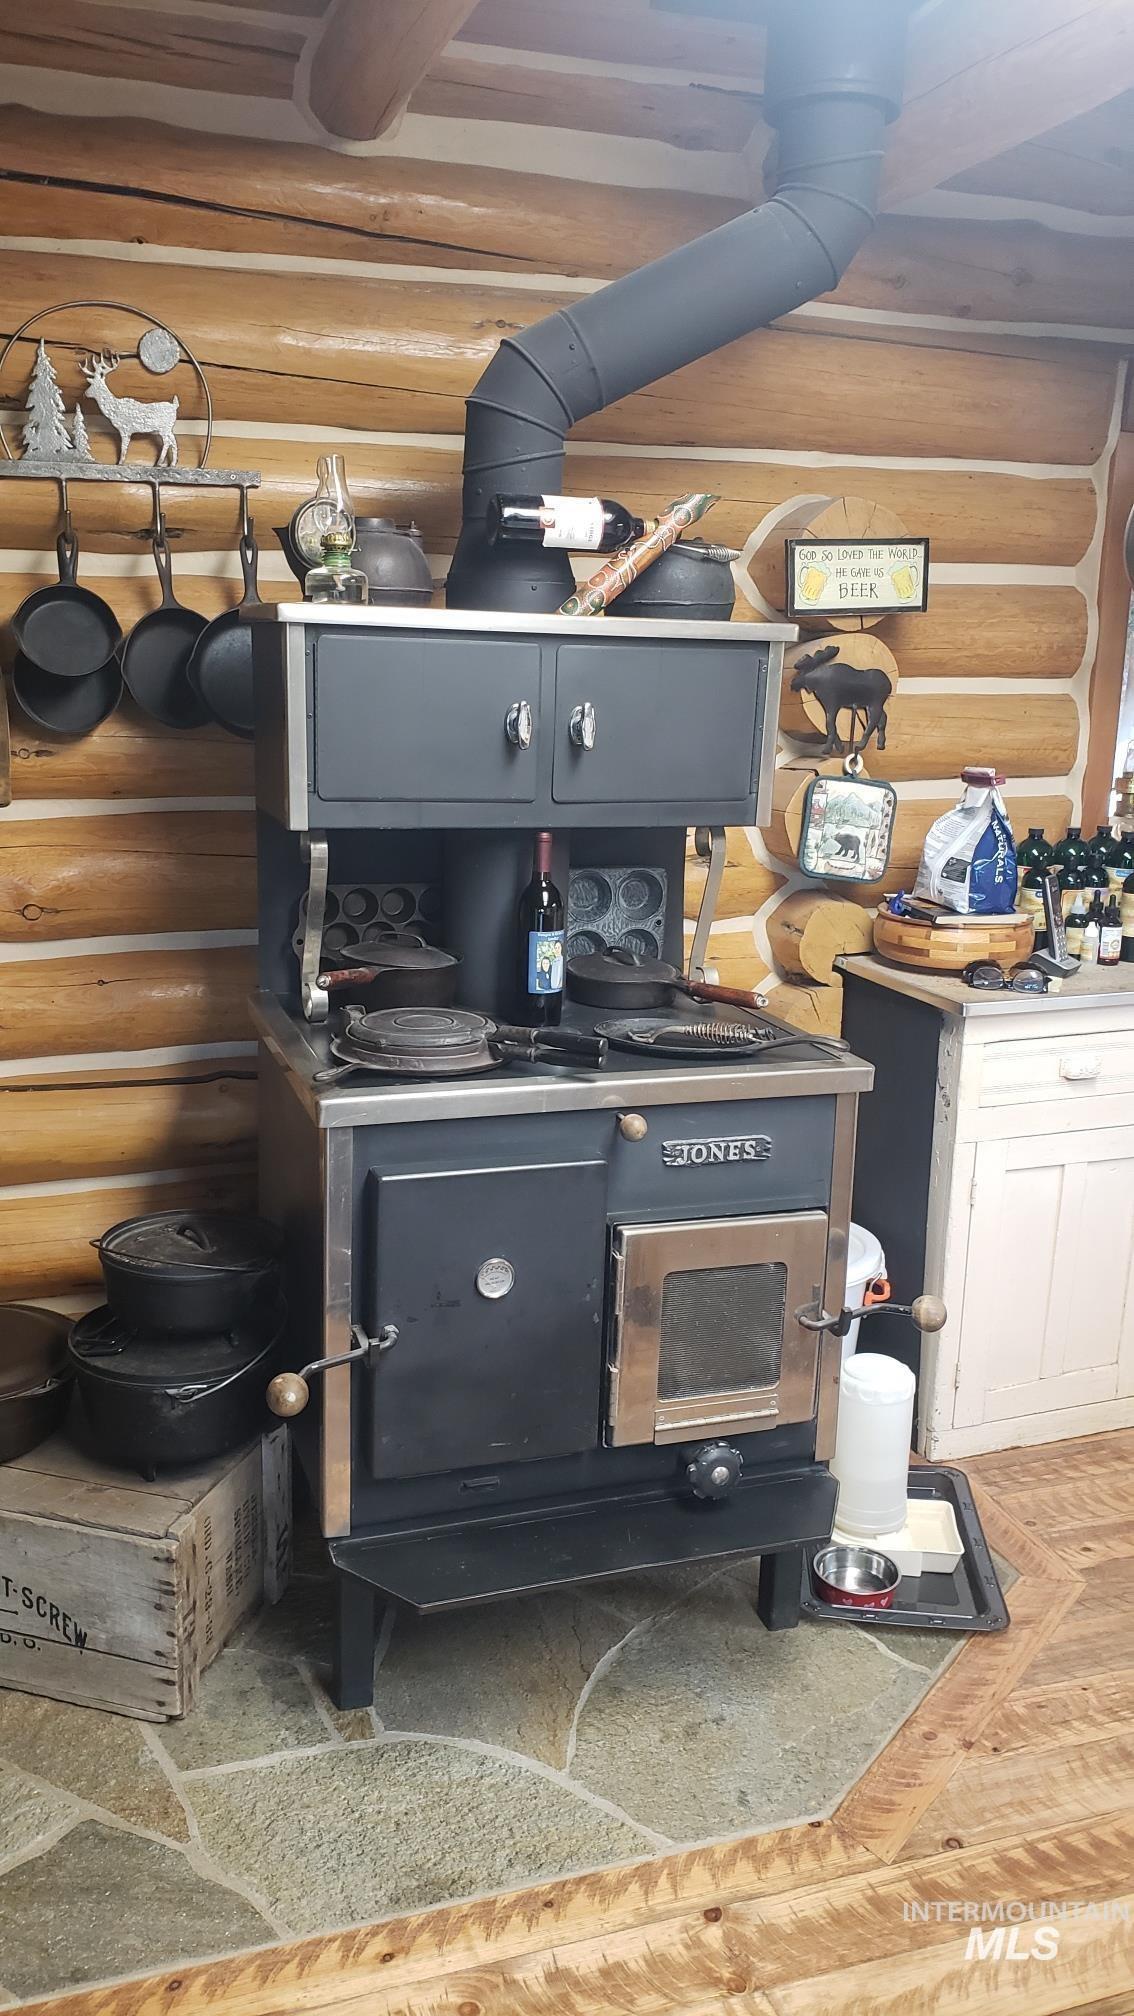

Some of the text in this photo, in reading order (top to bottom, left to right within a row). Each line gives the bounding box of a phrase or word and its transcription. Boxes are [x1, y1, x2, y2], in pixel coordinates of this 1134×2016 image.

[799, 548, 817, 561] GOD
[821, 549, 833, 562] SO
[837, 548, 864, 561] LOVED
[868, 548, 884, 560] THE
[835, 567, 885, 578] HE GAVE US
[839, 582, 879, 599] BEER
[992, 820, 1004, 884] NATURALS
[676, 1141, 756, 1165] JONES
